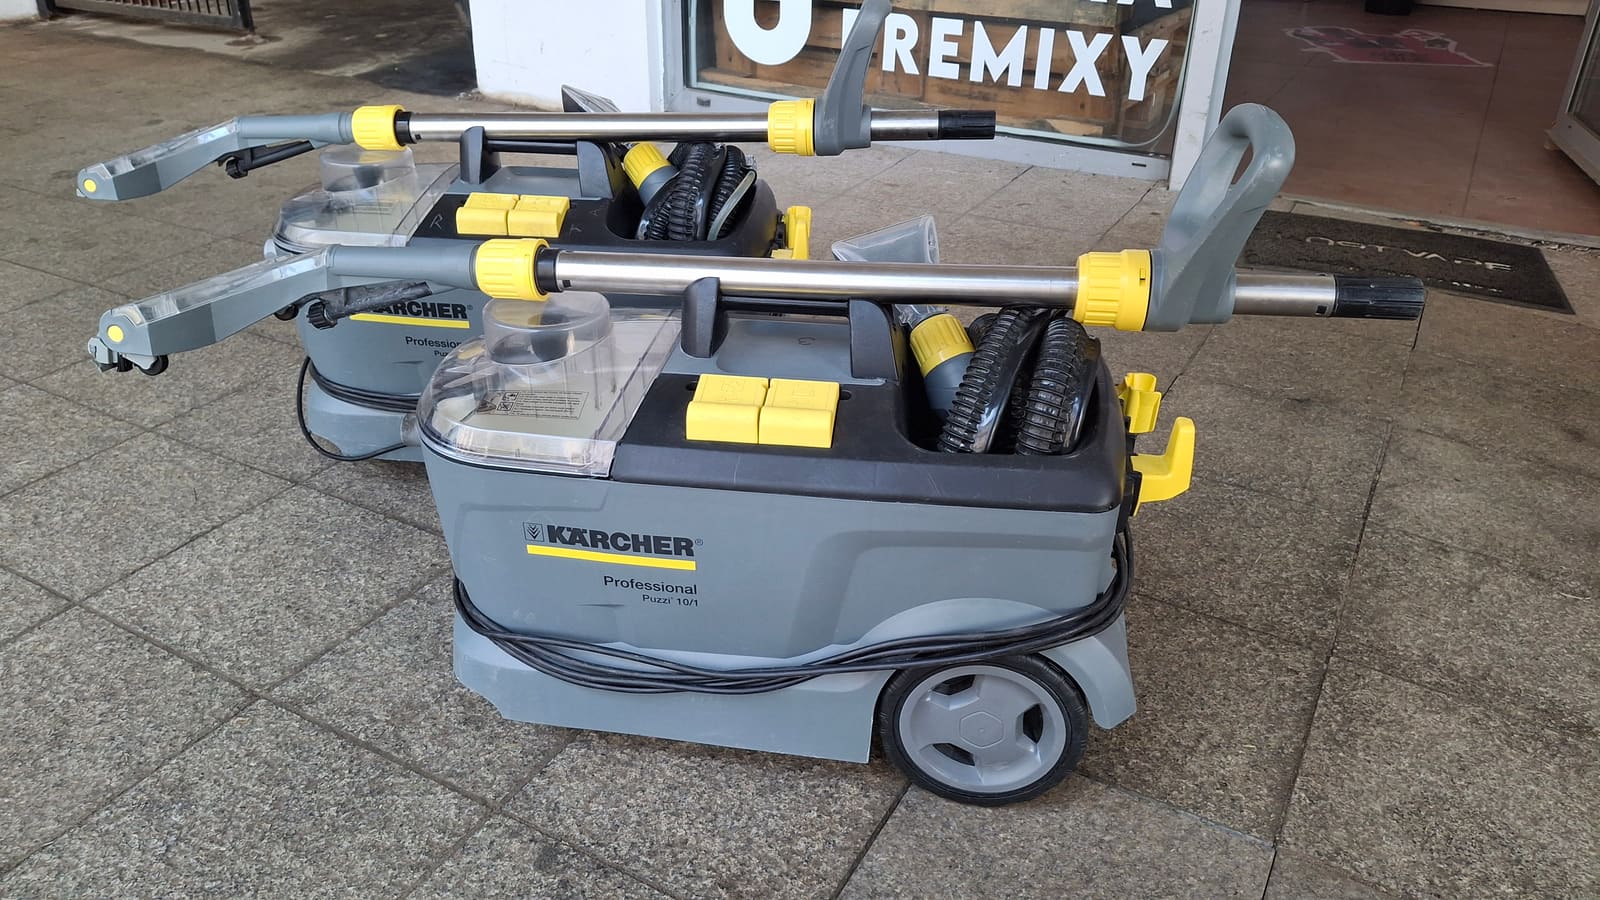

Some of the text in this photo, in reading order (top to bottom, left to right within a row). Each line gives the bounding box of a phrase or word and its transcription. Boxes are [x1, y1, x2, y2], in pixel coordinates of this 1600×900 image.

[373, 301, 467, 319] RCHER
[547, 525, 694, 556] KÄRCHER
[604, 575, 697, 595] Professional
[642, 595, 699, 607] Puzzi 10/1
